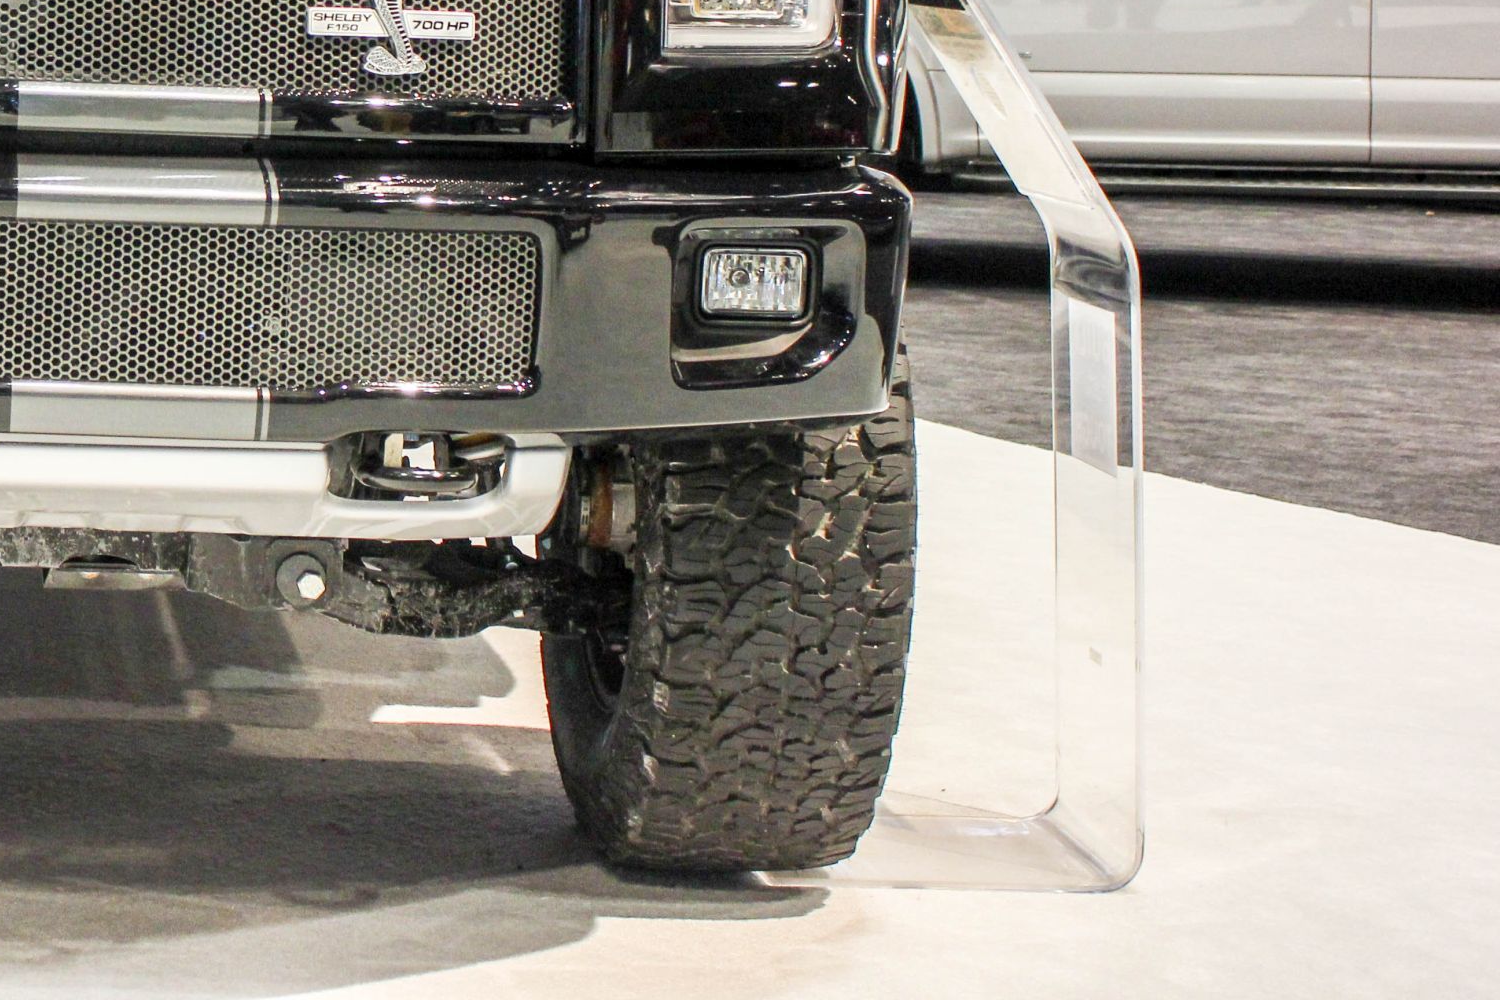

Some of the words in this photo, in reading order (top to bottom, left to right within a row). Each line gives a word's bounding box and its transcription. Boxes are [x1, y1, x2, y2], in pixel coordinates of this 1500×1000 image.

[313, 12, 373, 22] SHELBY
[326, 24, 359, 32] F150
[411, 20, 444, 31] 700
[446, 21, 469, 31] HP
